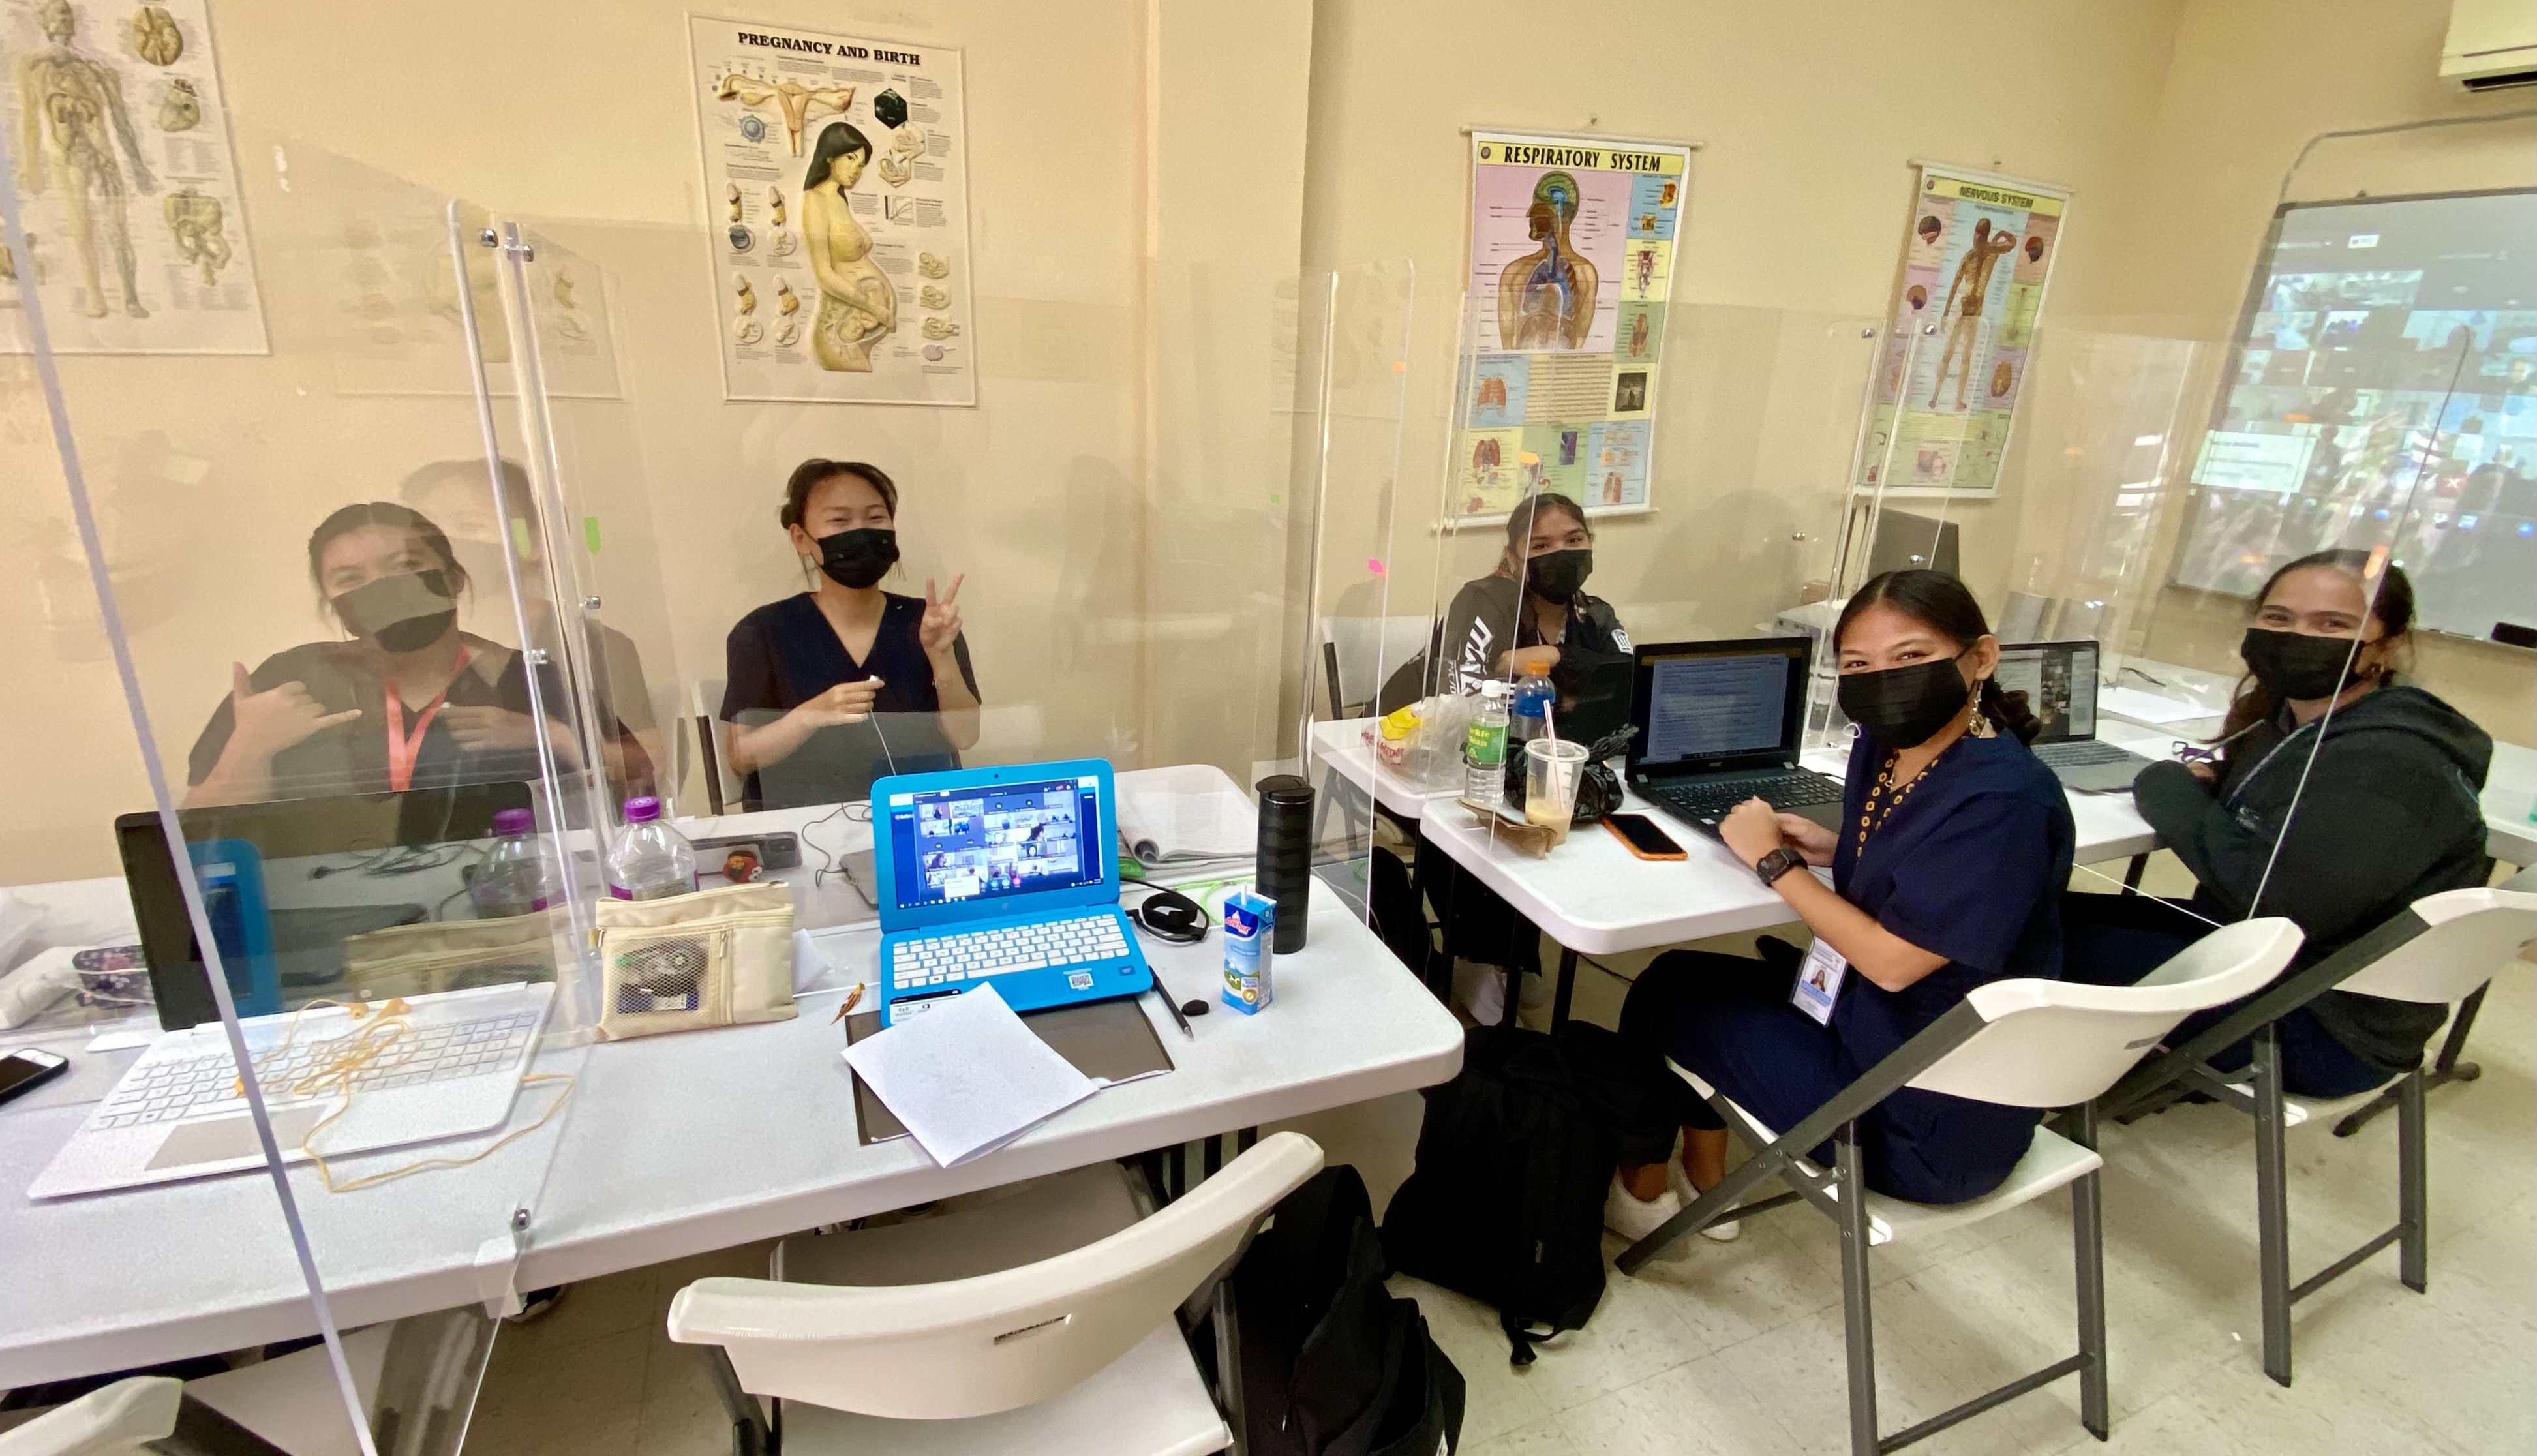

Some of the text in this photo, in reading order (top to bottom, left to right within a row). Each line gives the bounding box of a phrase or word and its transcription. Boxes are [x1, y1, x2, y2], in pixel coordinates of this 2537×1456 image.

[738, 32, 920, 65] PREGNANCY AND BIRTH
[1504, 146, 1660, 171] RESPIRATORY SYSTEM
[1959, 186, 2034, 208] NERVOUS SYSTEM
